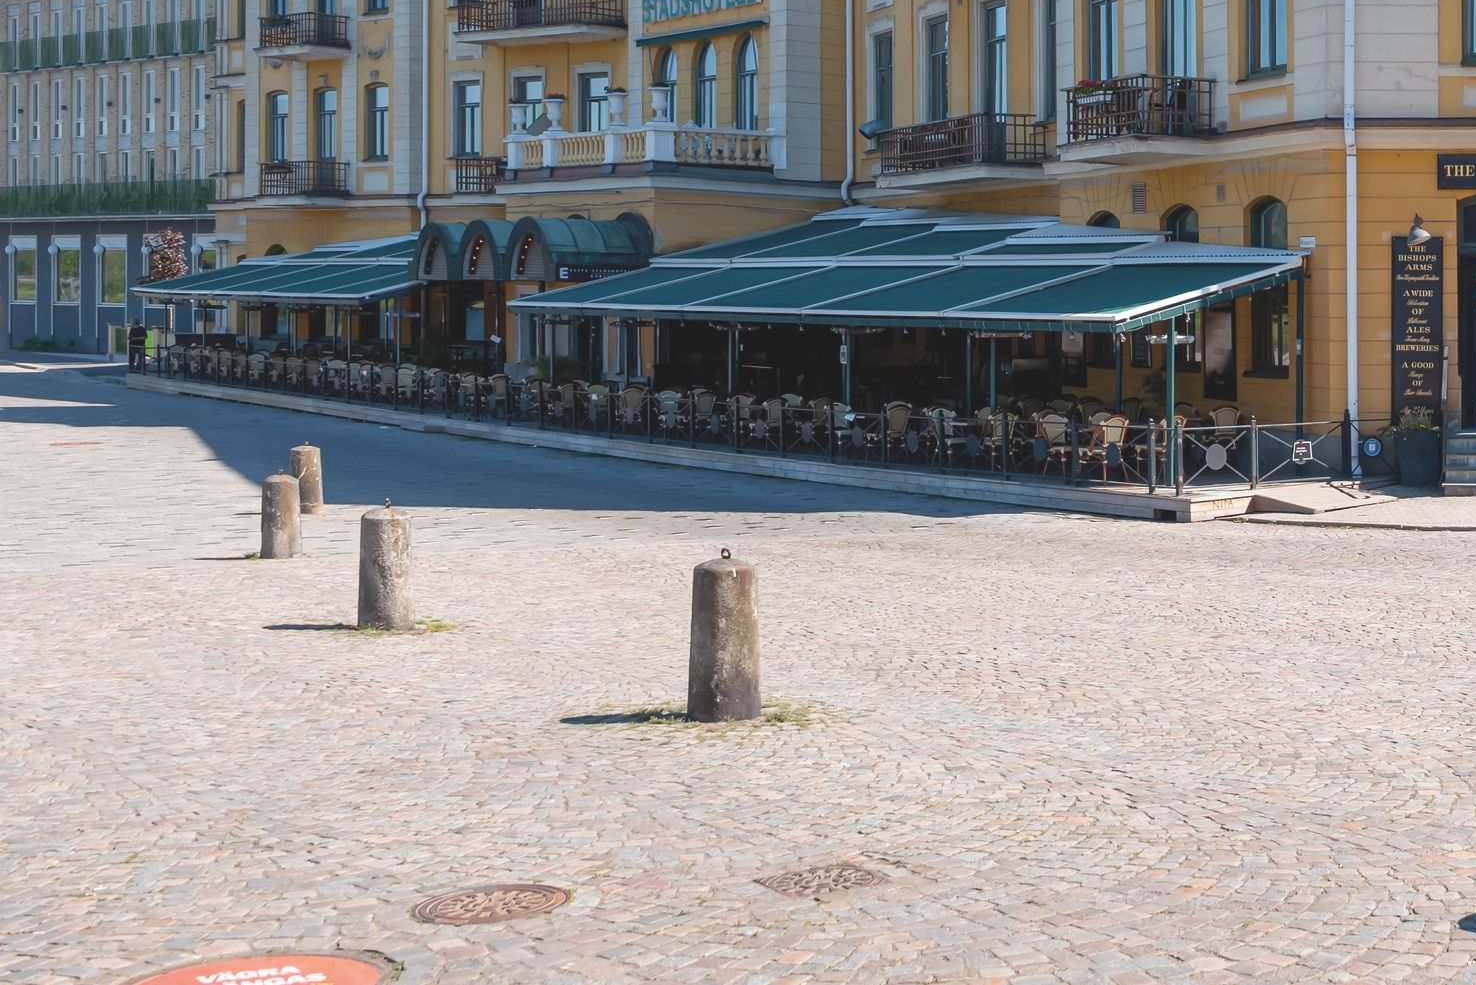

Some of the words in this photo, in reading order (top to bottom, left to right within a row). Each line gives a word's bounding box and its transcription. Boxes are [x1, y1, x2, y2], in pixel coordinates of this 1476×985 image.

[1444, 165, 1475, 177] THE
[1406, 326, 1430, 334] ALES
[1396, 344, 1439, 352] BREWERIES
[196, 966, 300, 984] VÄGRA
